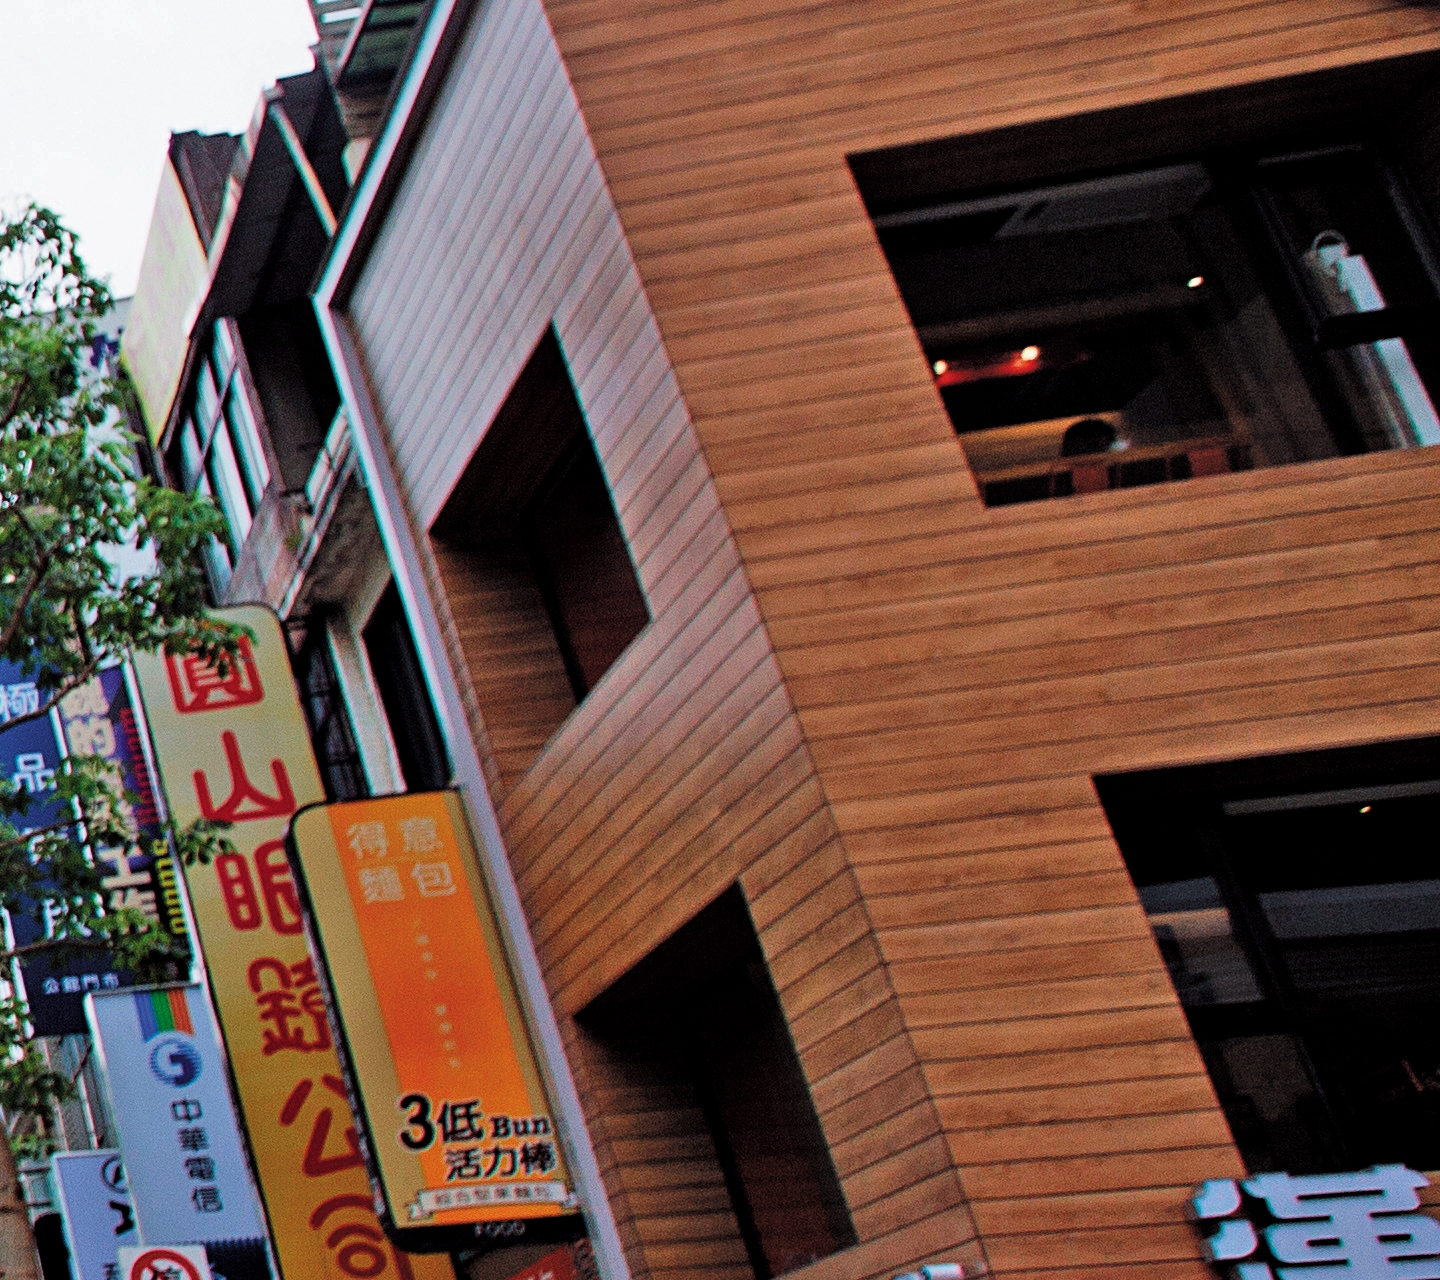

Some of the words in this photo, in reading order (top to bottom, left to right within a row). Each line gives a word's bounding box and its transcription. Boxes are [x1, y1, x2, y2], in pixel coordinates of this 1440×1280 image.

[491, 1116, 552, 1138] Bun
[171, 1097, 221, 1214] 中華電信
[446, 1140, 557, 1182] 活力棒
